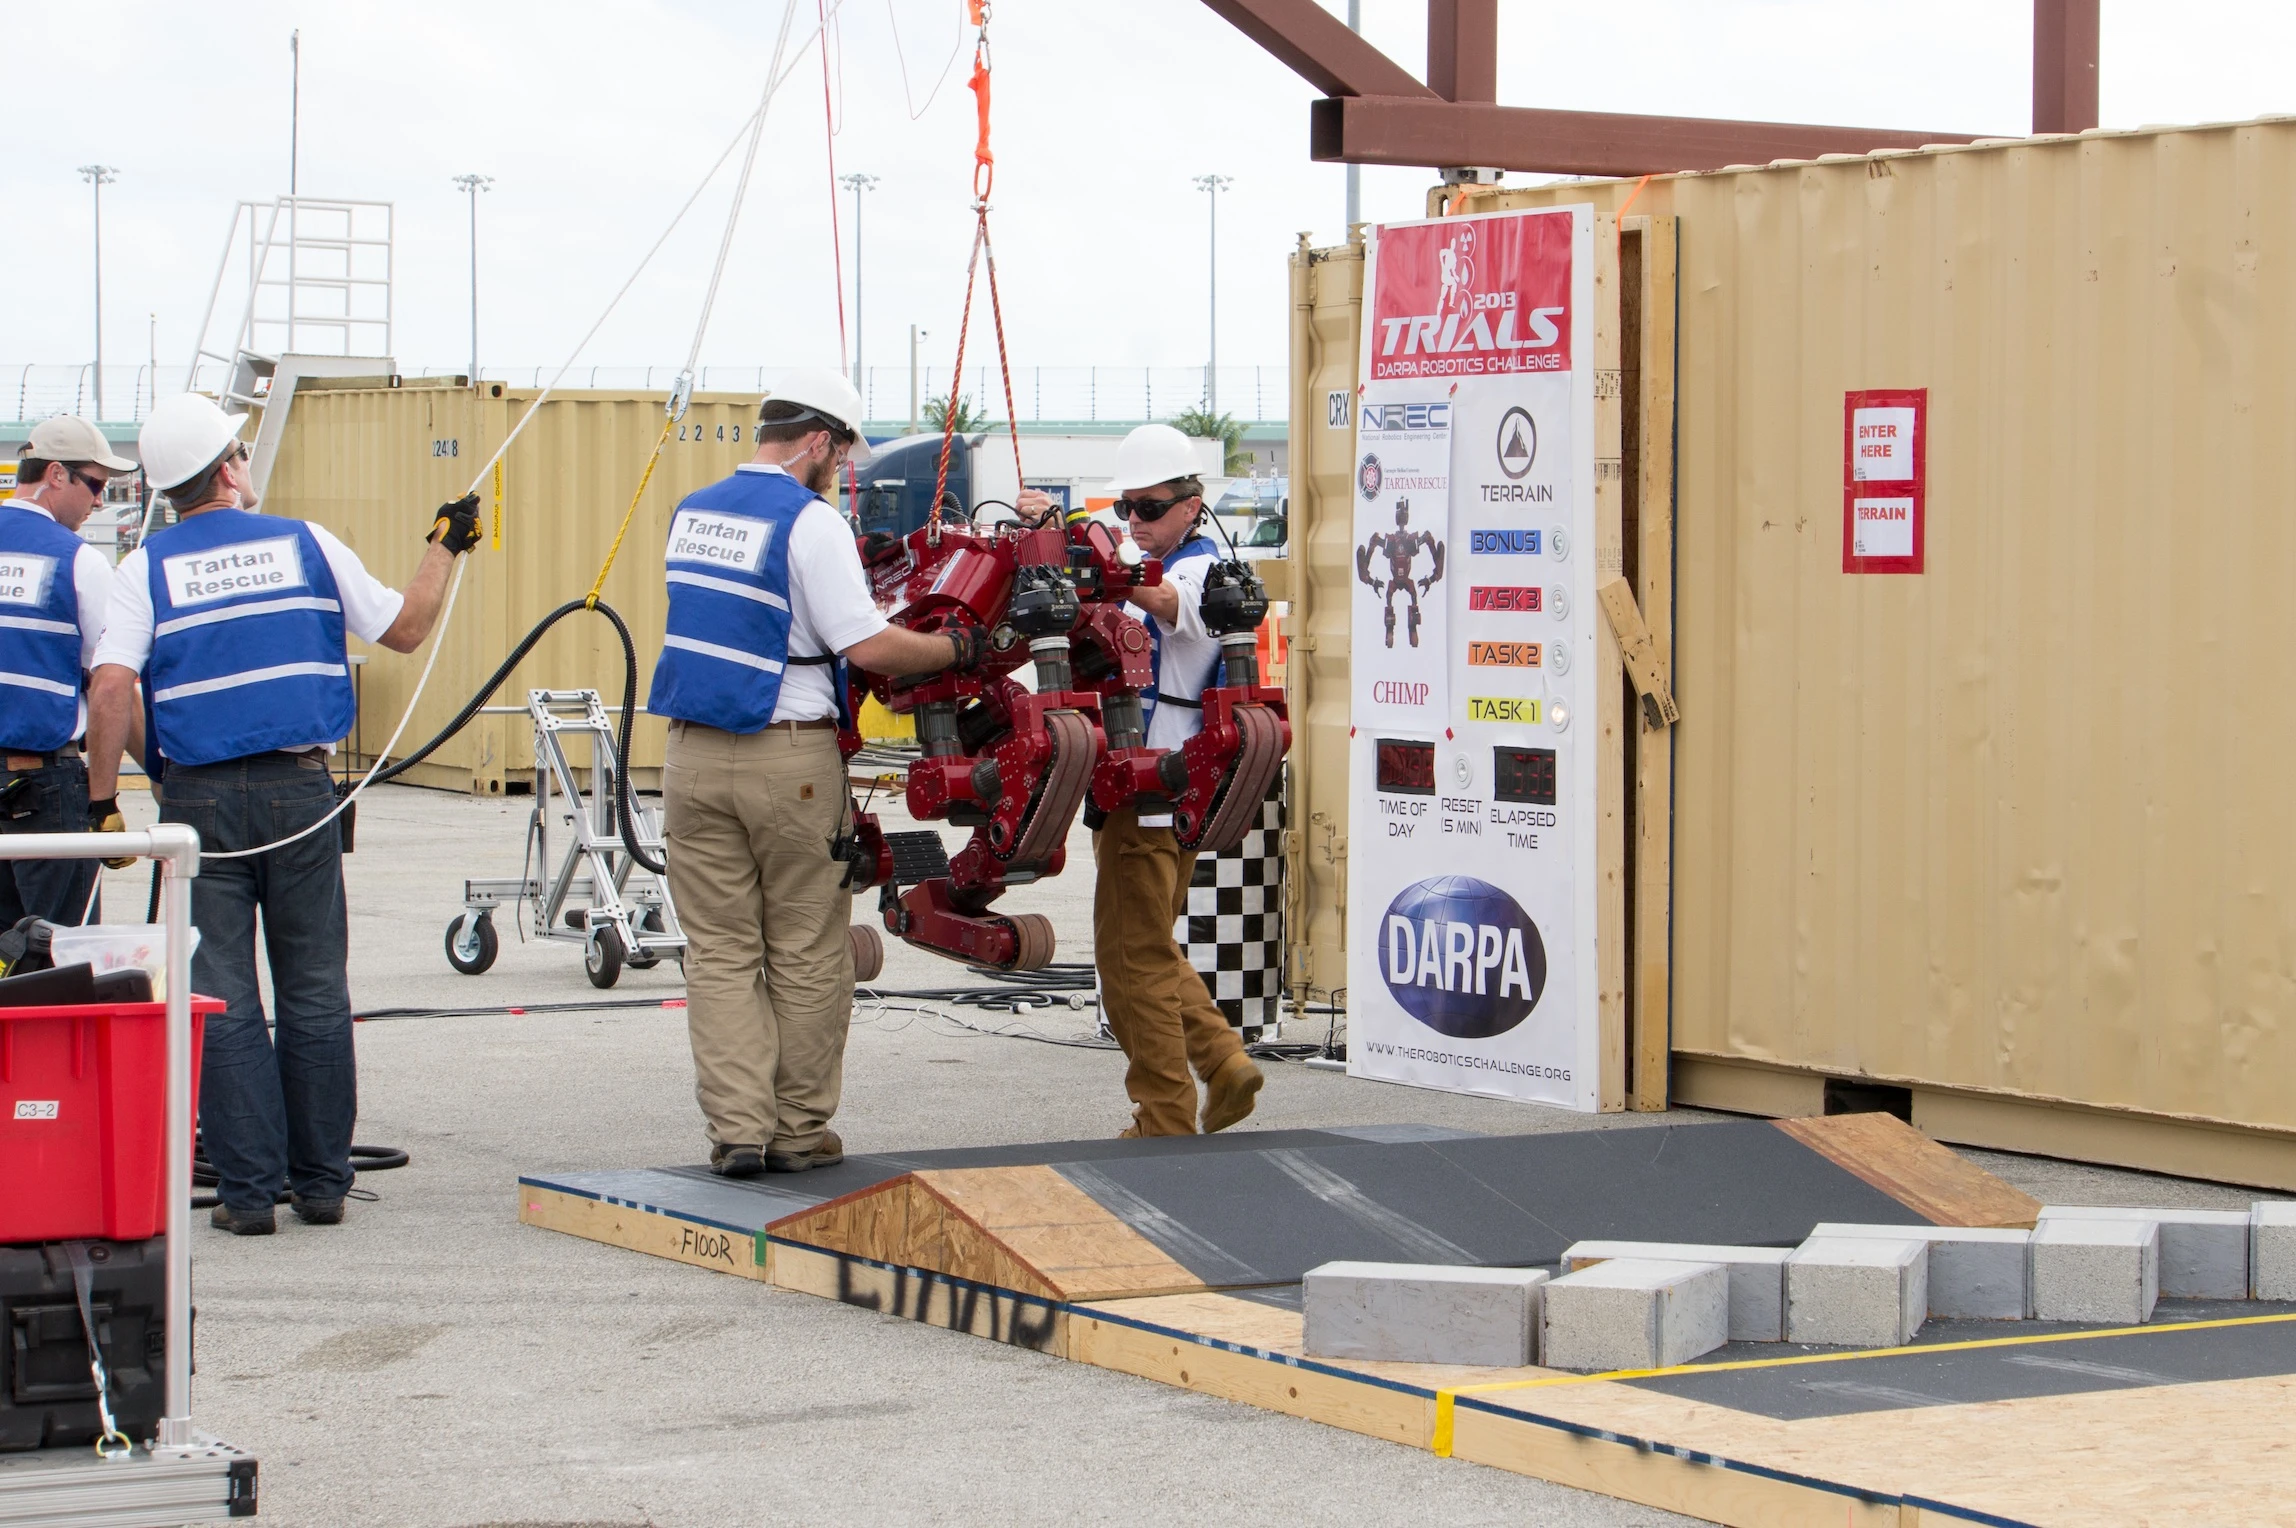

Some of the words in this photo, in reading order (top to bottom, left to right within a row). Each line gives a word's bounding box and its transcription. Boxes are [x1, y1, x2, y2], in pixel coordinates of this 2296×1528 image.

[1474, 292, 1516, 309] 2013
[1381, 306, 1564, 356] TRIALS
[1377, 361, 1418, 377] DARPA
[1420, 357, 1484, 375] ROBOTICS
[1487, 353, 1561, 372] CHALLENGE
[1362, 405, 1449, 429] NREC
[1859, 425, 1897, 438] ENTER
[1861, 445, 1892, 458] HERE
[1481, 485, 1553, 502] TERRAIN
[1858, 507, 1906, 521] TERRAIN
[687, 518, 748, 542] Tartan
[675, 538, 745, 563] Rescue
[1474, 532, 1537, 552] BONUS
[185, 549, 274, 577] Tartan
[185, 570, 284, 598] Rescue
[875, 566, 911, 593] NREC
[1474, 589, 1523, 610] TASK
[1526, 590, 1540, 611] 3
[1472, 644, 1524, 665] TASK
[1527, 646, 1539, 665] 2
[1373, 680, 1429, 706] CHIMP
[1472, 699, 1523, 721] TASK
[1531, 702, 1535, 721] 1
[1379, 799, 1407, 816] TIME
[1410, 802, 1427, 817] OF
[1441, 797, 1482, 814] RESET
[1440, 817, 1453, 833] (5
[1456, 819, 1482, 837] MIN)
[1490, 808, 1556, 828] ELAPSED
[1388, 822, 1415, 838] DAY
[1507, 833, 1539, 850] TIME
[1388, 914, 1533, 1002] DARPA
[1366, 1041, 1571, 1082] WWW.THEROBOTICSCHALLENGE.ORG
[17, 1103, 55, 1117] C3-2
